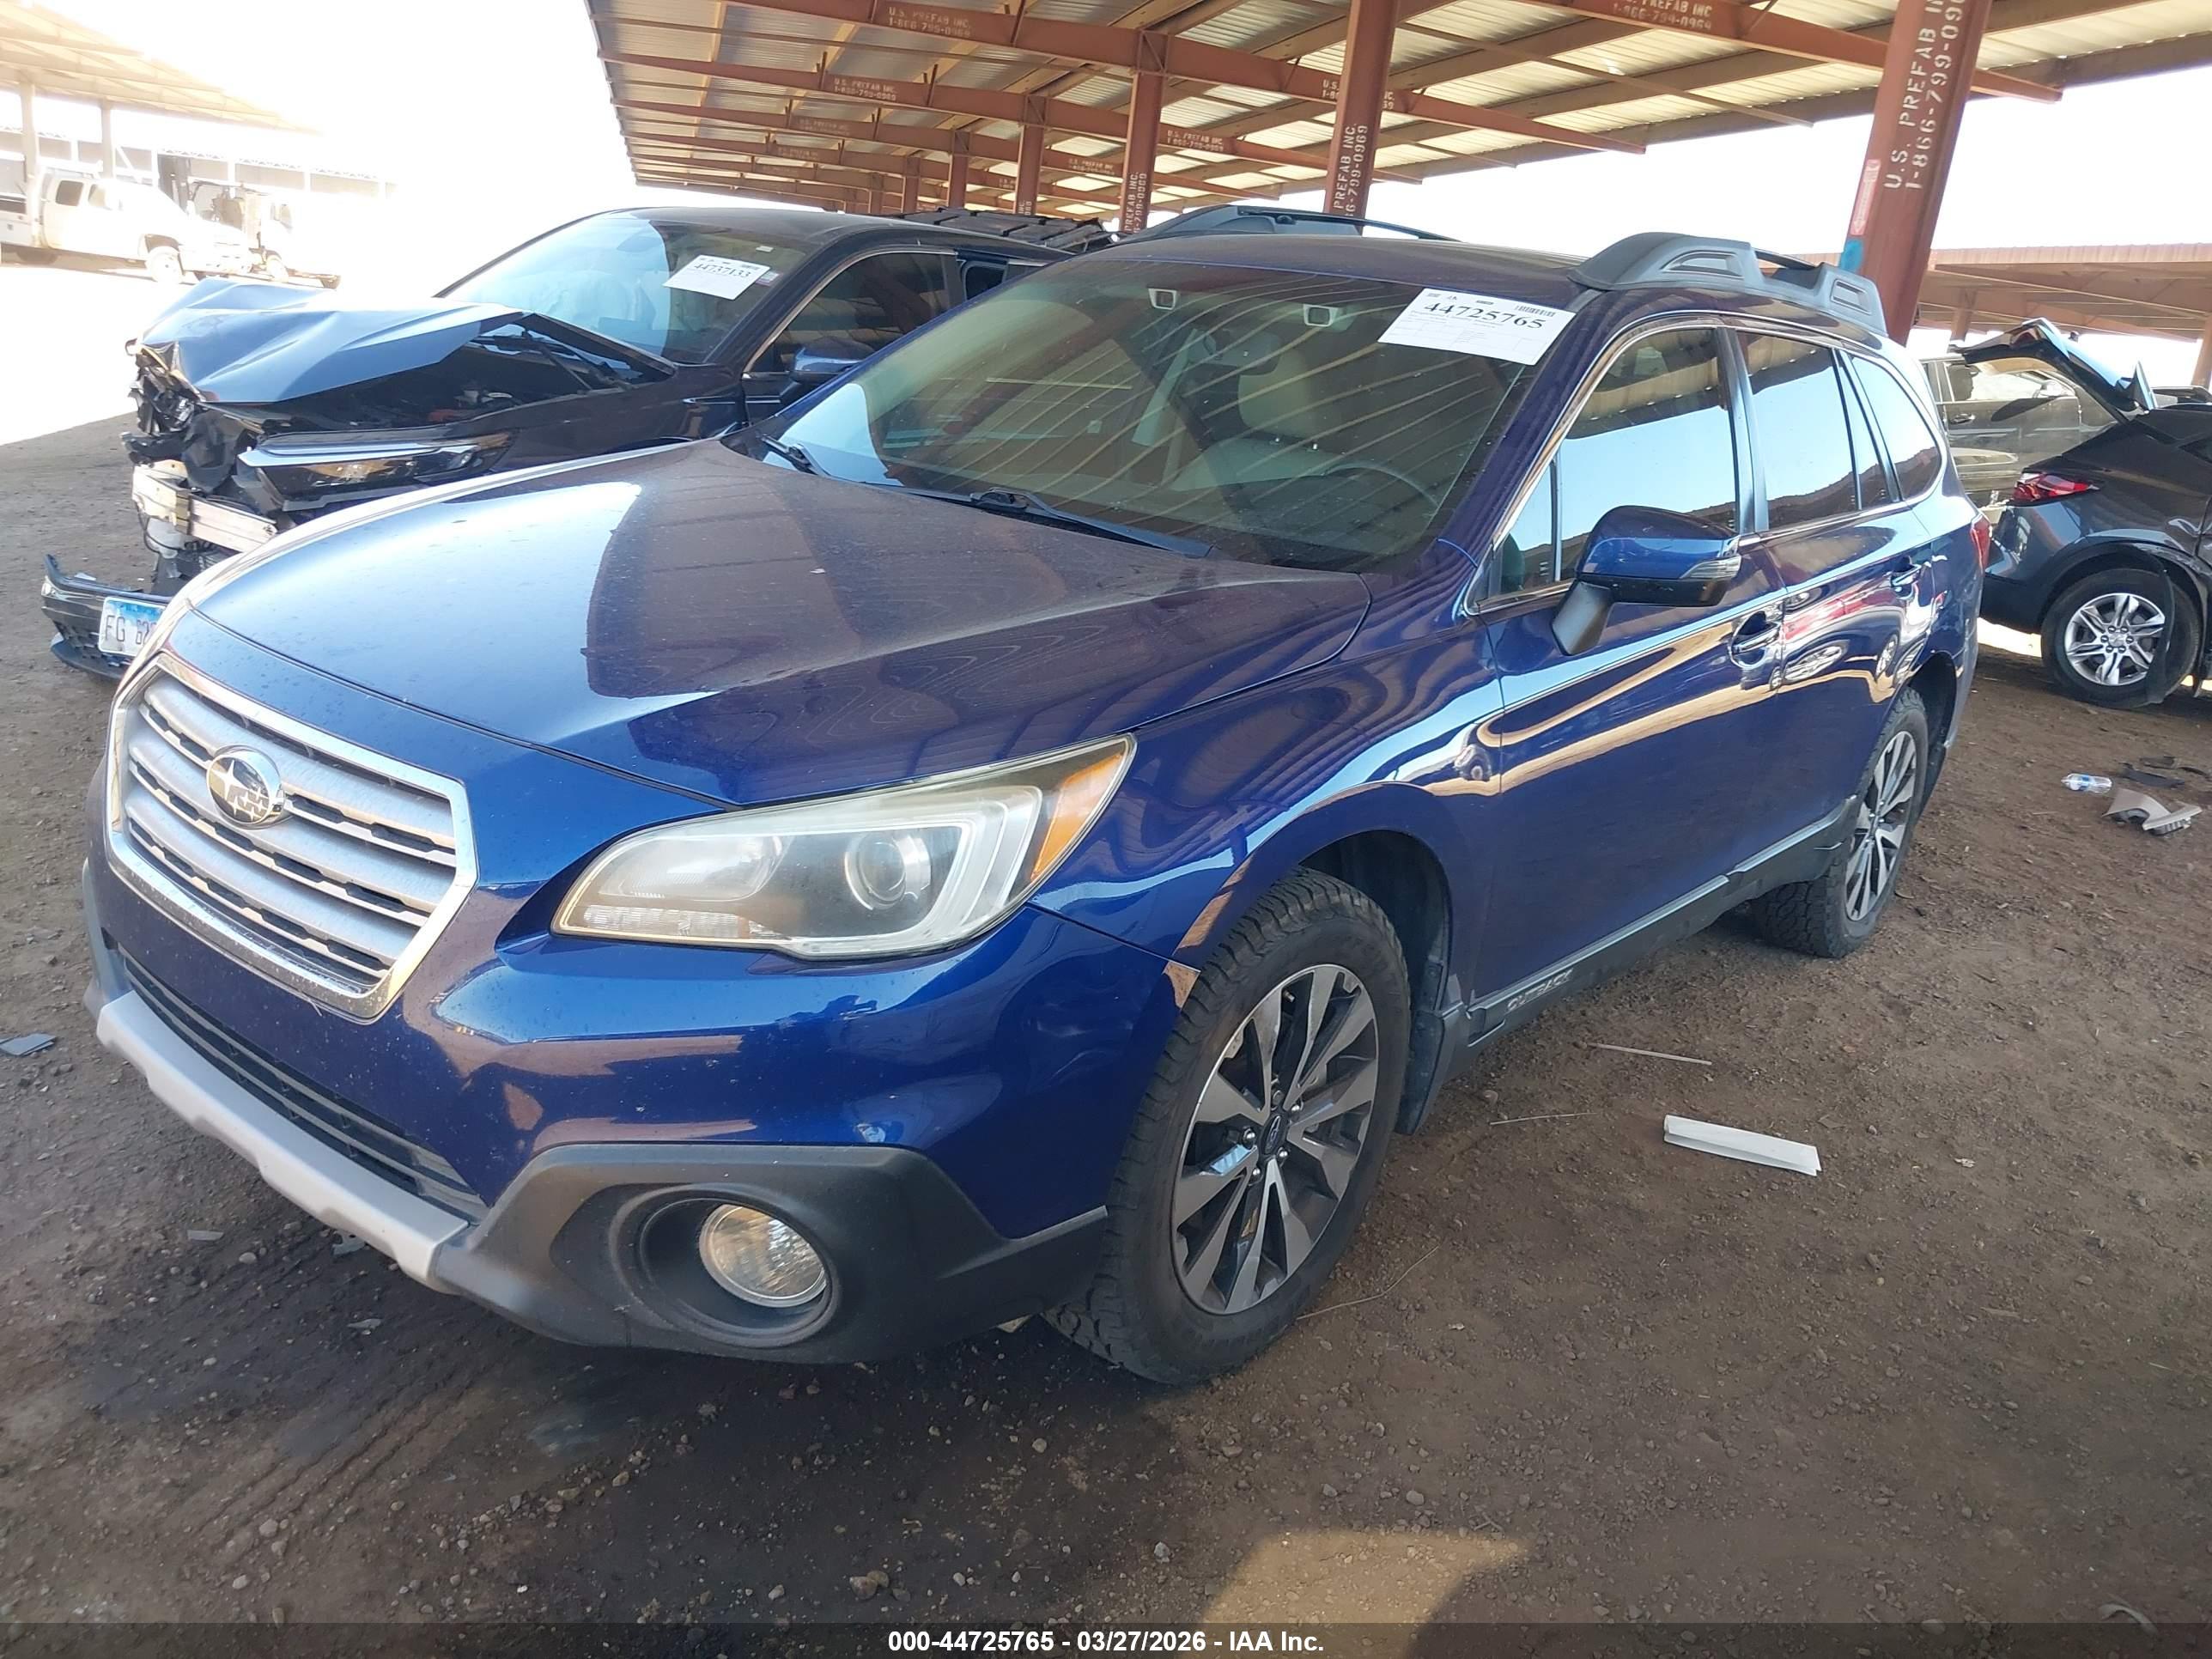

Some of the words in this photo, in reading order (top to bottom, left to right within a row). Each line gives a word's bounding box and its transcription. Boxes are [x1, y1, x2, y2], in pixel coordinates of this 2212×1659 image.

[1883, 143, 1911, 189] U.S.
[1899, 27, 1936, 127] PREFAB
[1905, 0, 1966, 189] 1-866-799-09
[1342, 123, 1357, 149] INC.
[1333, 155, 1352, 210] PREFAB
[1124, 194, 1136, 232] PREFAB
[1424, 302, 1547, 330] 44725765
[106, 615, 125, 642] FG
